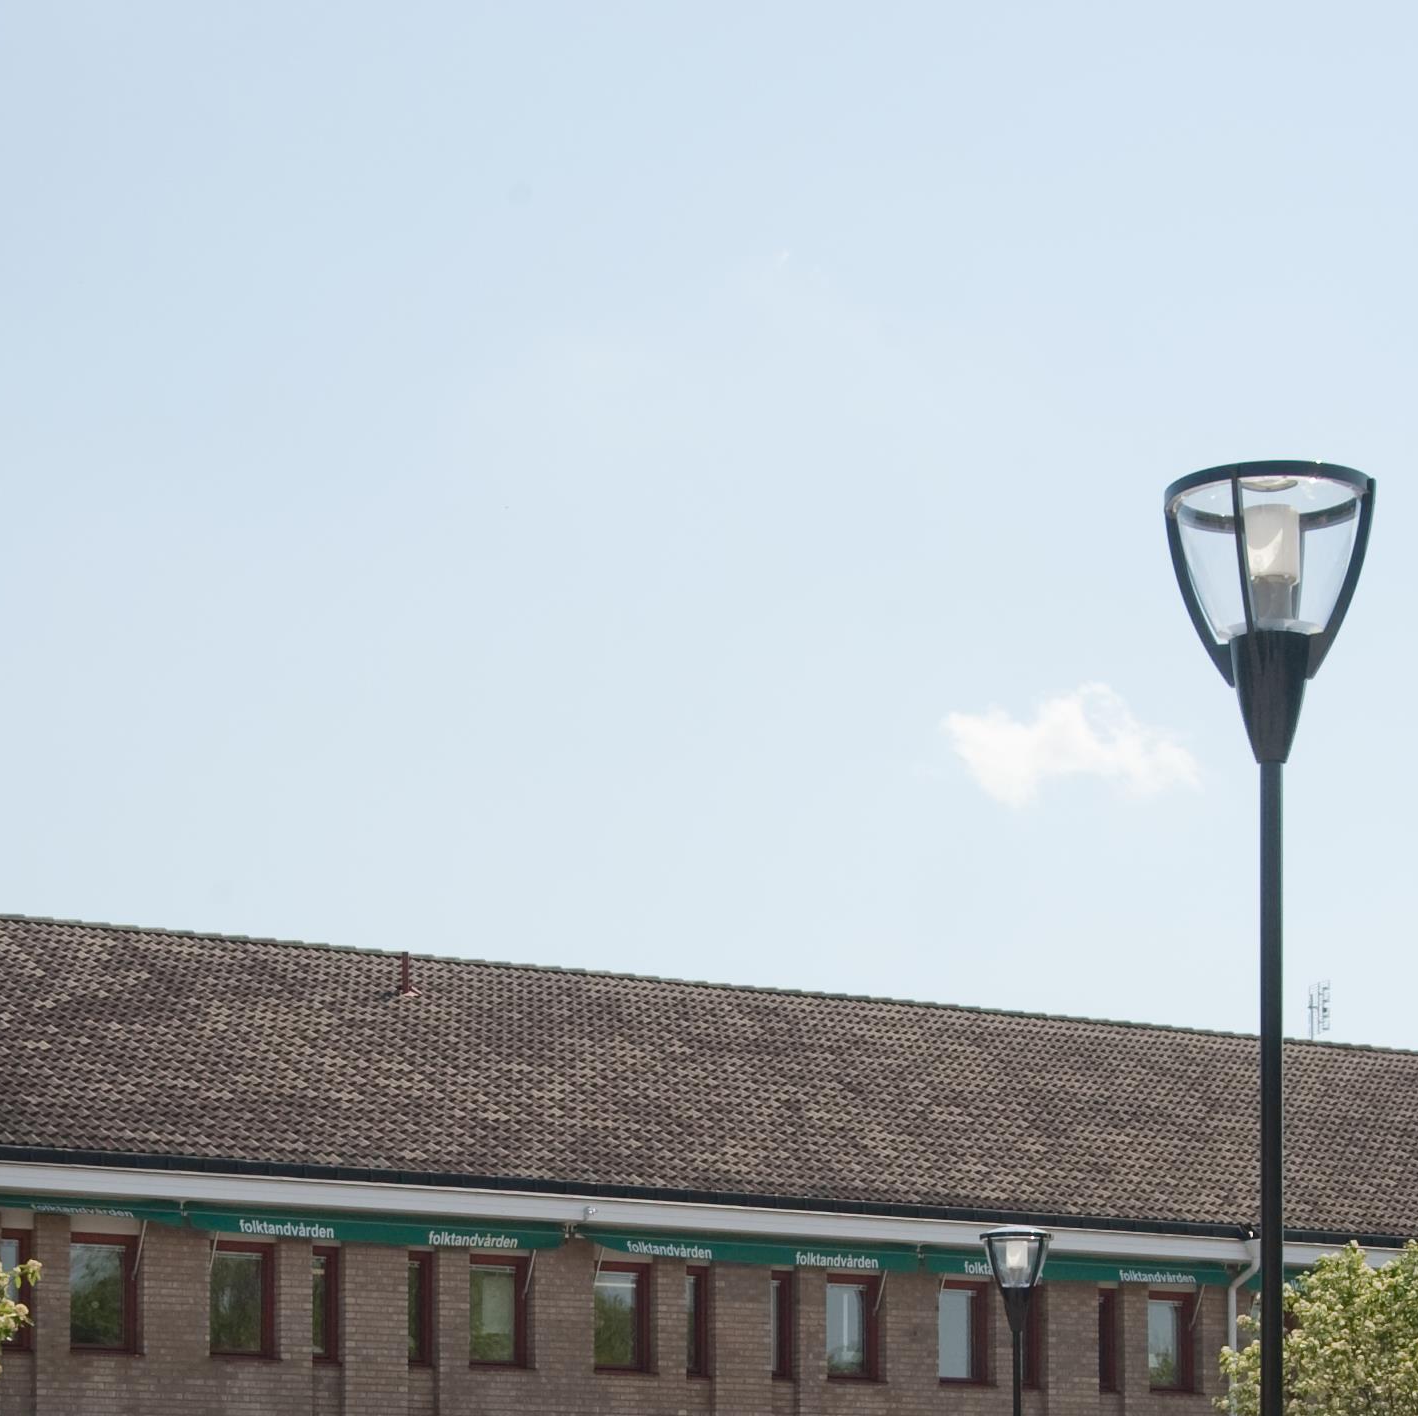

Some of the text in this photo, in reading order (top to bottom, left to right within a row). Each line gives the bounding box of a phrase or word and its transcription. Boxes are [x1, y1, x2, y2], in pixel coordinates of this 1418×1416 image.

[239, 1218, 335, 1239] folktandvården
[428, 1230, 518, 1248] folktandvården
[626, 1240, 712, 1259] folktandvården
[795, 1251, 879, 1269] folktandvården
[1119, 1269, 1197, 1283] folktandvården
